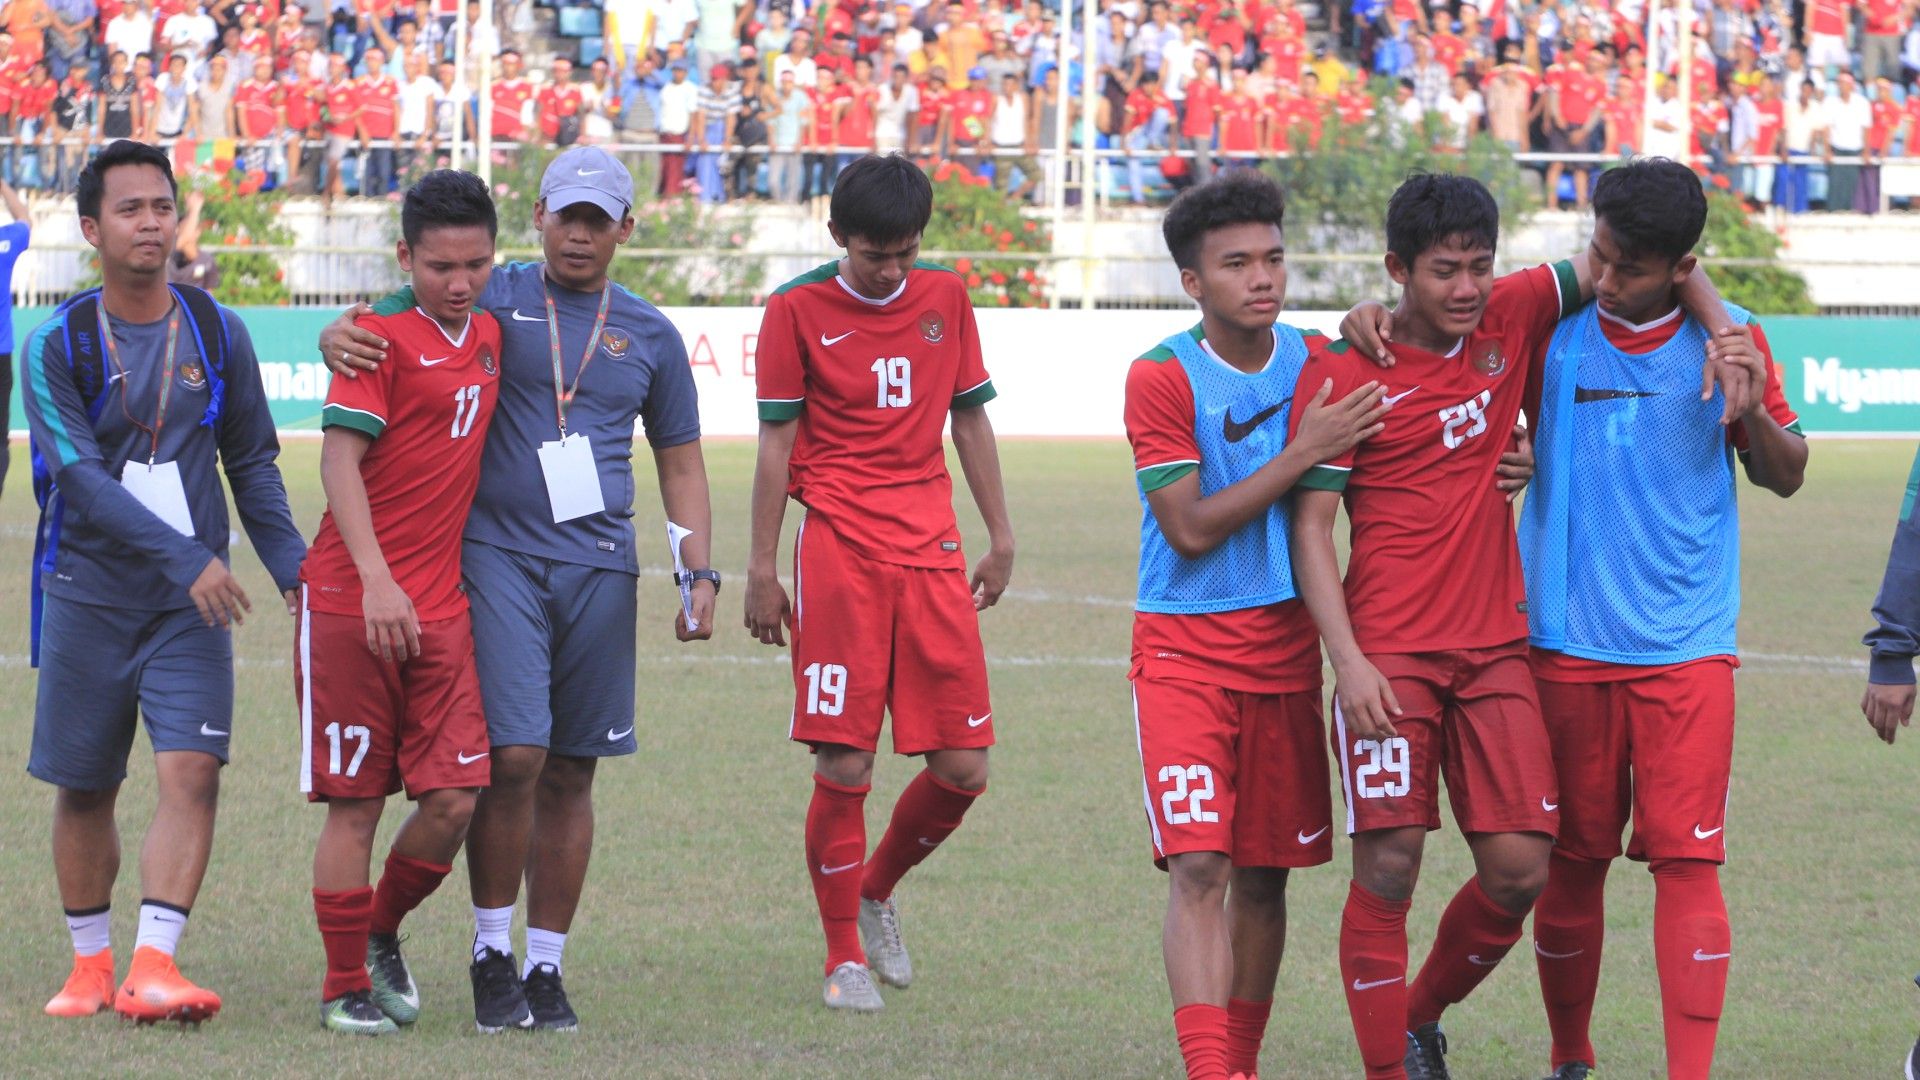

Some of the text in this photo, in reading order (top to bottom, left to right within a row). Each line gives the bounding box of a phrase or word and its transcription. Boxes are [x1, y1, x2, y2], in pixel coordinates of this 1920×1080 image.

[78, 330, 93, 356] AIR
[870, 356, 912, 408] 19
[450, 383, 481, 439] 17
[1438, 388, 1491, 450] 29
[803, 662, 848, 717] 19
[324, 721, 370, 778] 17
[1353, 736, 1411, 799] 29
[1158, 764, 1219, 825] 22
